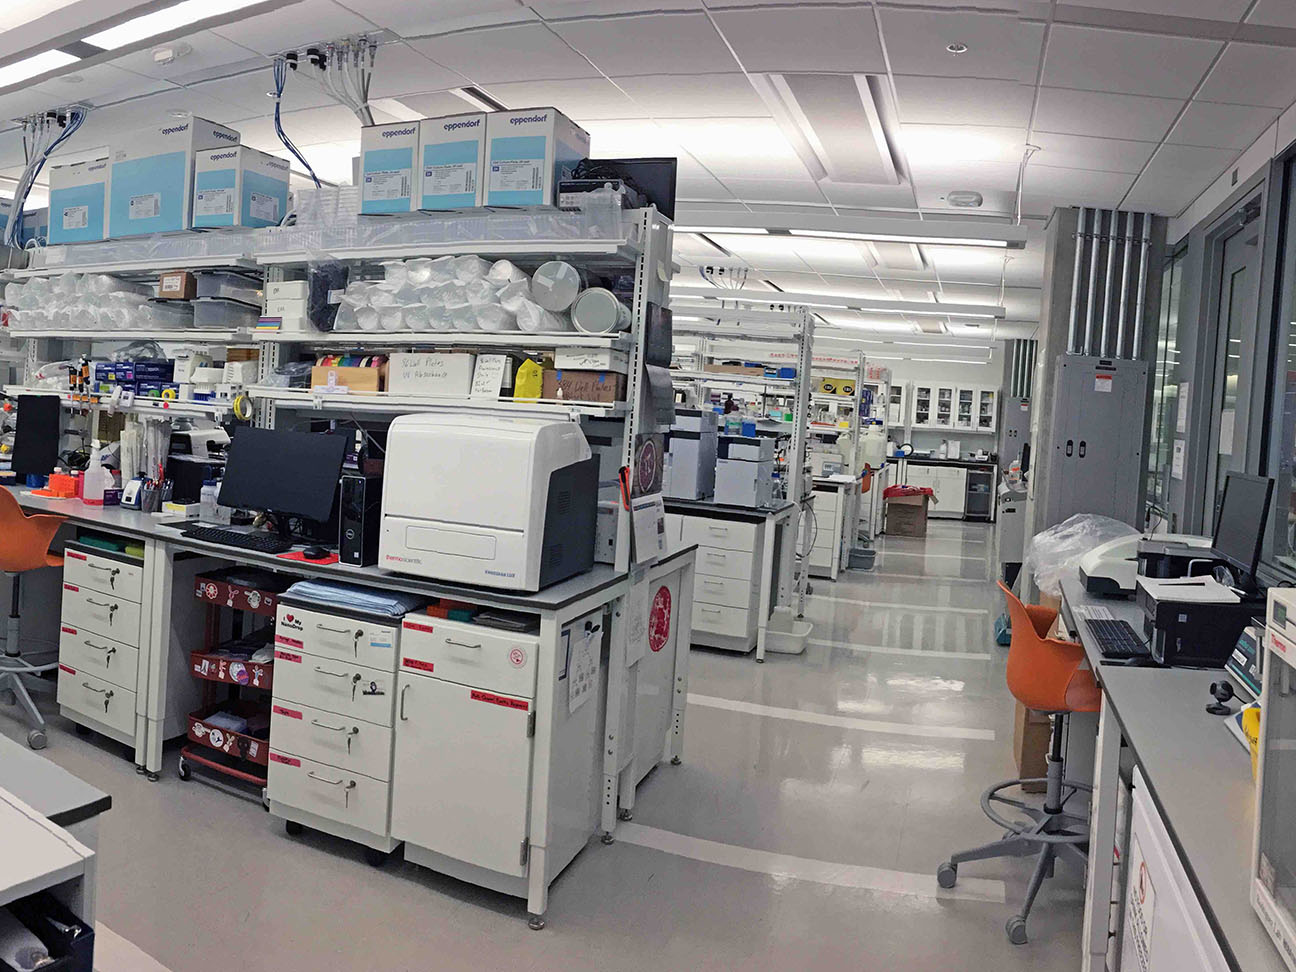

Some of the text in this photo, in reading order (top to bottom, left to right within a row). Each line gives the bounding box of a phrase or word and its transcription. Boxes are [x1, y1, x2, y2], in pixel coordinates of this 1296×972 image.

[444, 119, 481, 132] eppendorf
[510, 114, 548, 126] eppendorf
[162, 124, 189, 136] eppendorf
[212, 130, 238, 142] eppendorf
[382, 127, 416, 139] eppendorf
[210, 151, 238, 162] eppendorf
